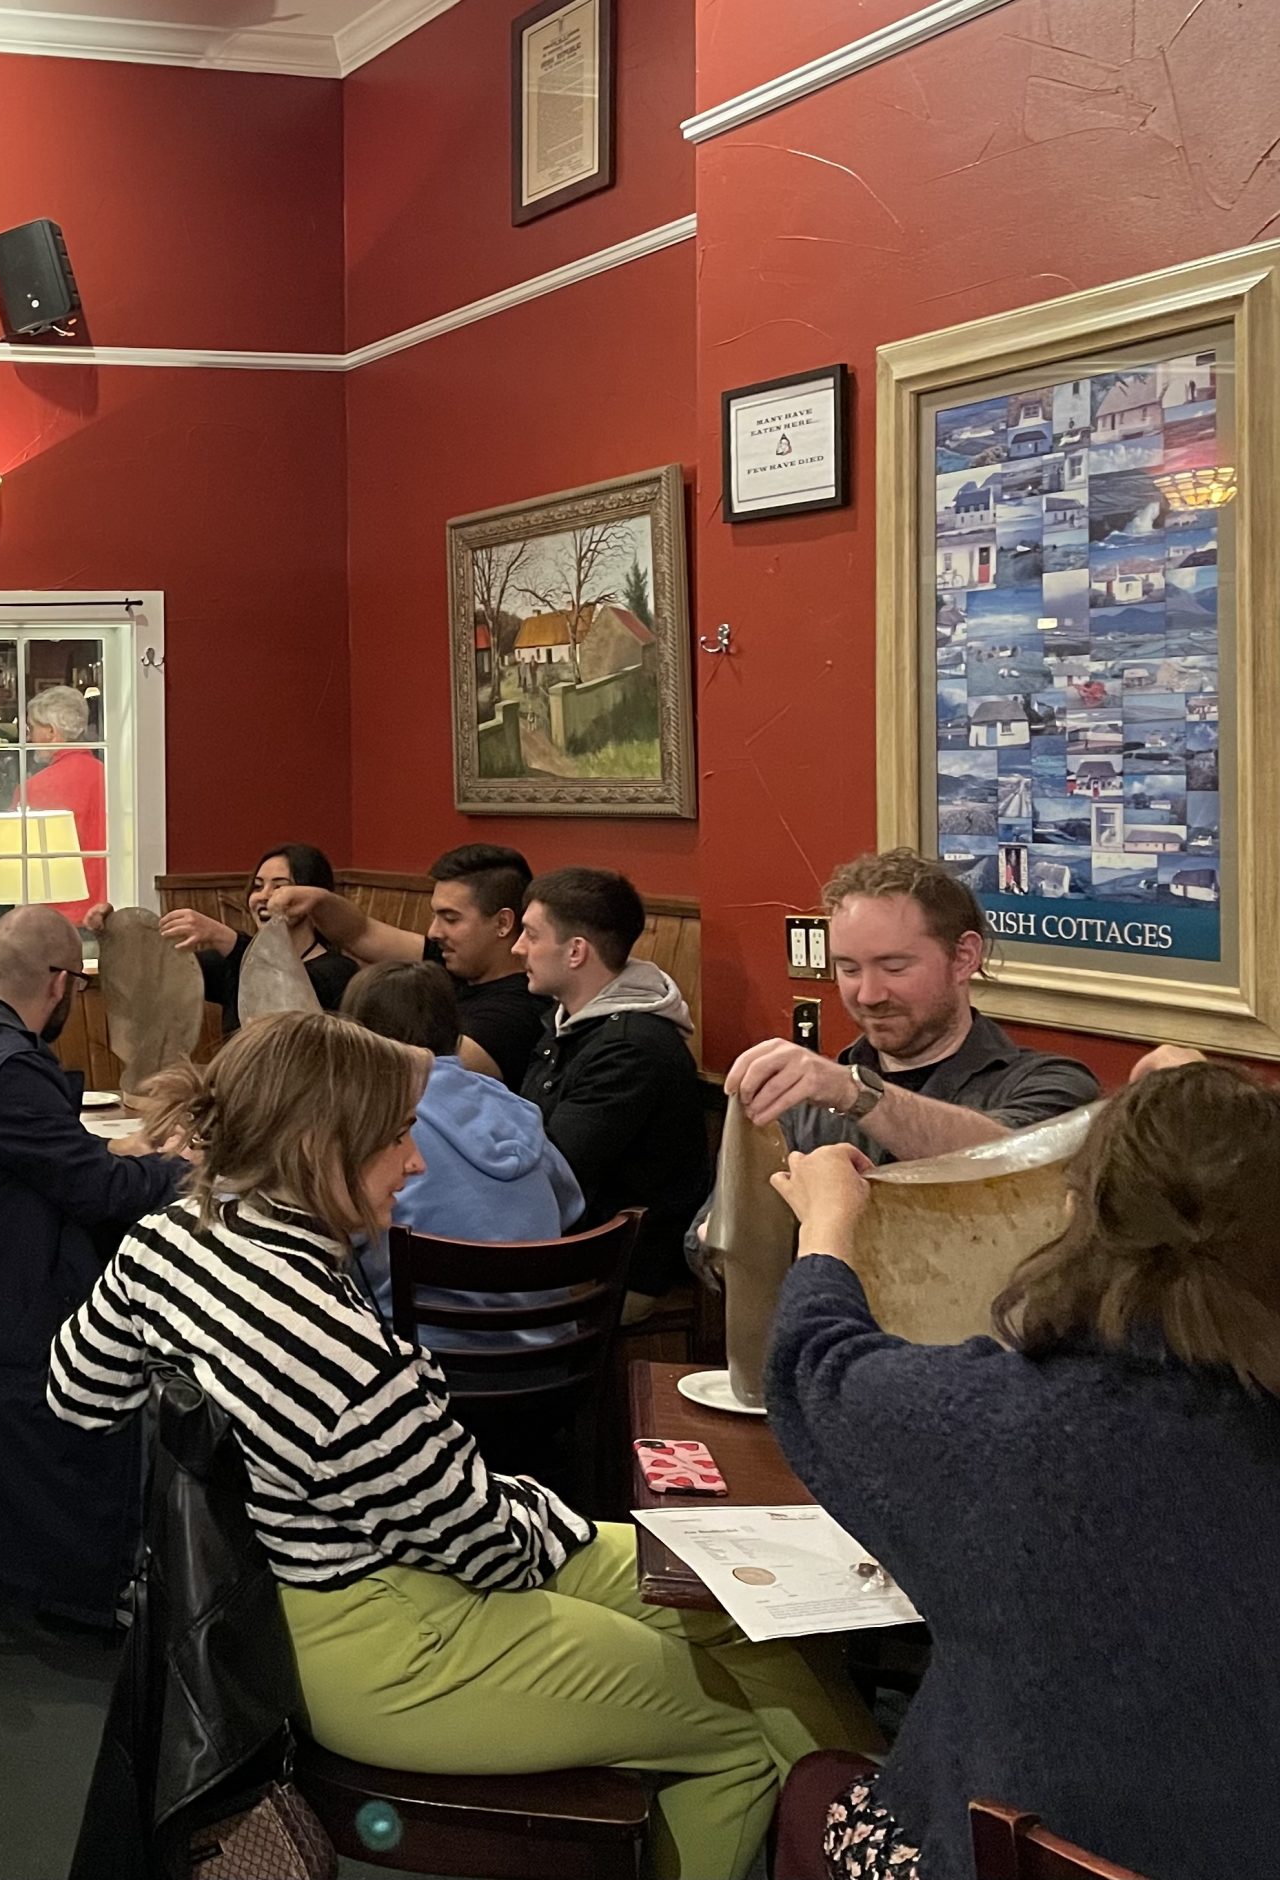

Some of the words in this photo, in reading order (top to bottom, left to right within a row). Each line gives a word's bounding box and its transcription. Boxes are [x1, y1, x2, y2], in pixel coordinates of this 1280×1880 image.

[756, 414, 783, 425] MANY
[784, 408, 813, 419] HAVE
[750, 425, 782, 437] EATEN
[747, 466, 767, 475] FEW
[769, 460, 797, 471] HAVE
[798, 455, 824, 465] DIED
[984, 910, 1036, 936] RISH
[1041, 915, 1173, 949] COTTAGES
